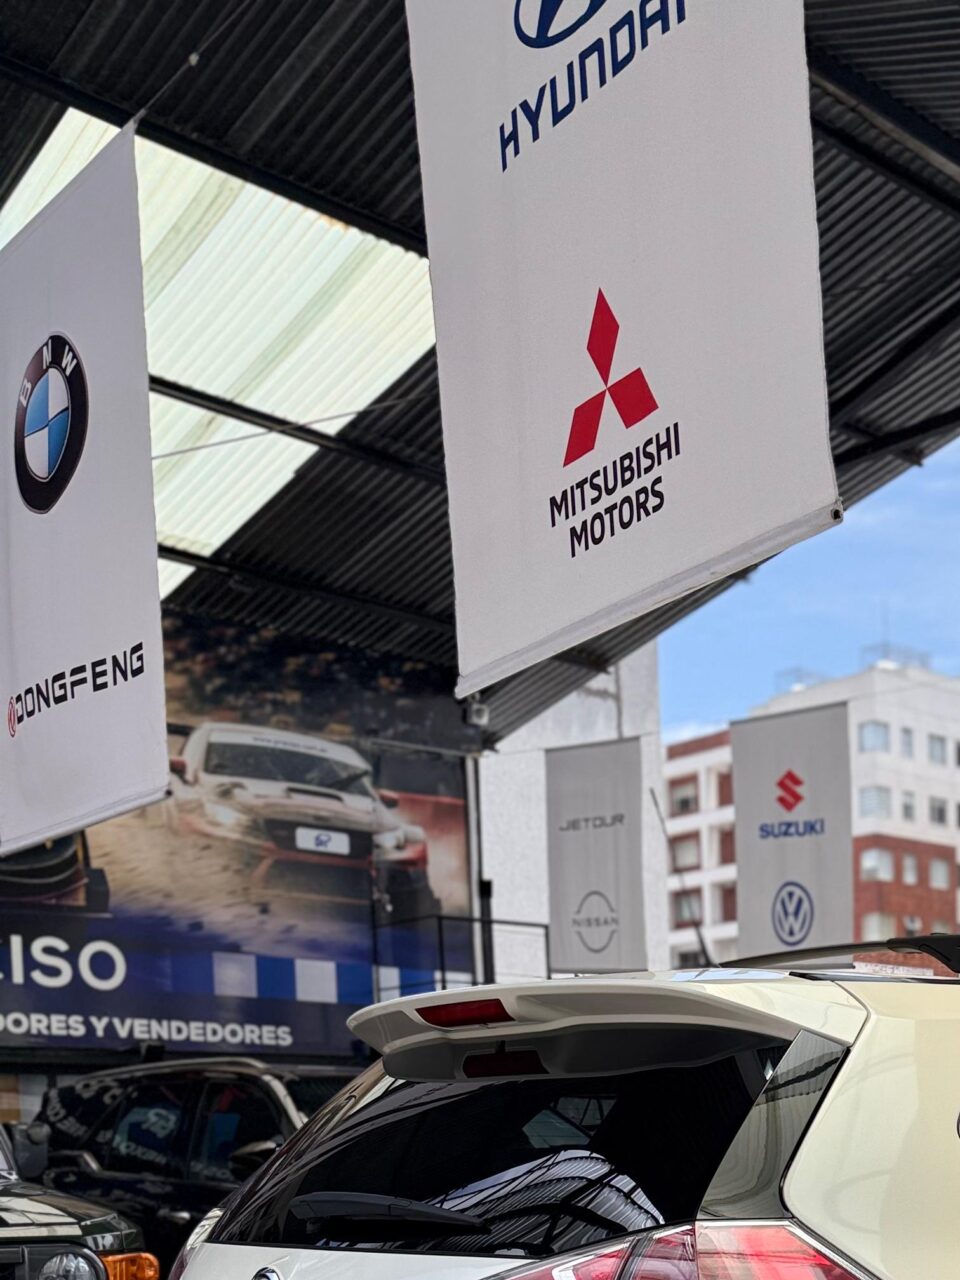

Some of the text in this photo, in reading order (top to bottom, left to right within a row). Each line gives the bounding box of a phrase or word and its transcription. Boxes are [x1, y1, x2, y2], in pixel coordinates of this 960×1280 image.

[549, 421, 680, 528] MITSUBISHI
[569, 475, 665, 558] MOTORS
[15, 641, 145, 725] DONGFENG
[558, 813, 625, 832] JETOUR
[758, 818, 826, 839] SUZUKI
[571, 917, 620, 928] NISSAN
[0, 934, 127, 991] ISO
[89, 1015, 110, 1038] Y
[111, 1016, 293, 1047] VENDEDORES
